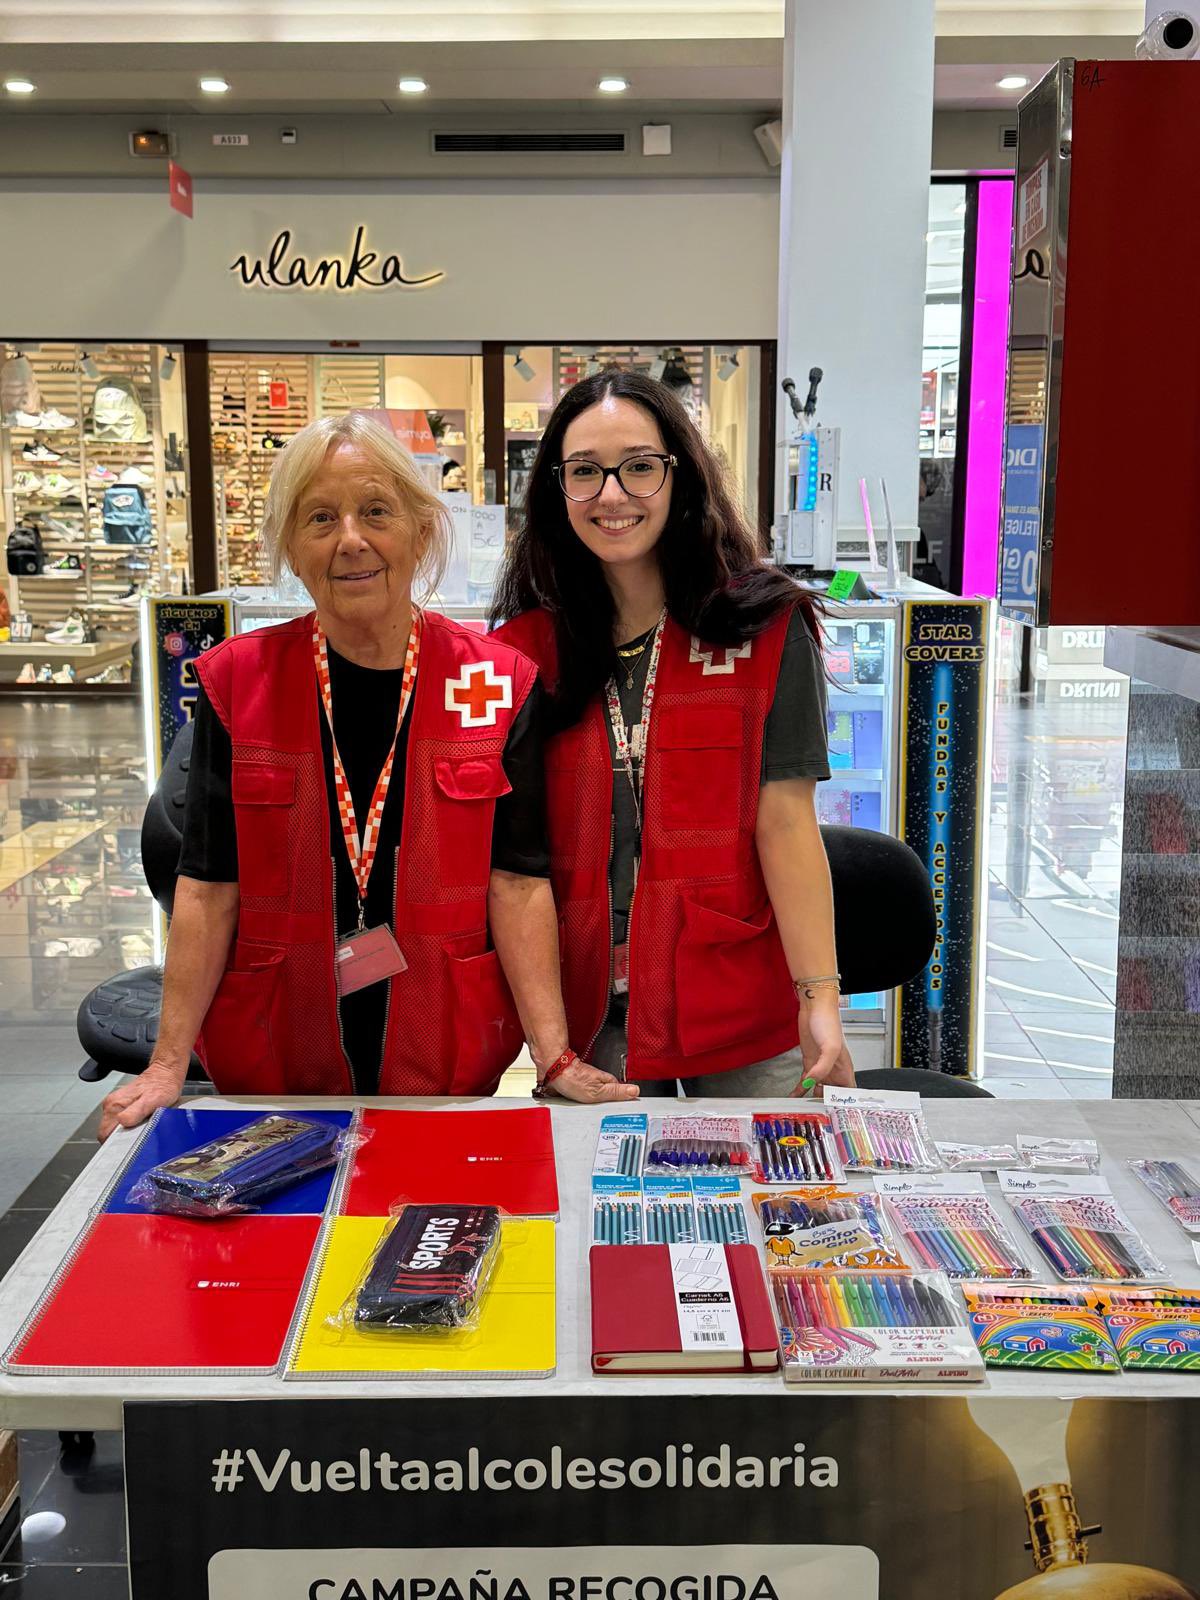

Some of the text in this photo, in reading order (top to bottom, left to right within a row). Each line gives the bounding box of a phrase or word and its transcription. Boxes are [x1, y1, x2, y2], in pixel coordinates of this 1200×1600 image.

[230, 227, 443, 287] ulanka
[919, 624, 973, 640] STAR
[904, 645, 985, 662] COVERS
[935, 702, 949, 793] FUNDAS
[933, 811, 946, 825] Y
[409, 1217, 460, 1271] SPORTS
[800, 1227, 862, 1248] Comfor
[826, 1236, 858, 1249] Grip
[937, 1370, 968, 1378] ALPINO
[211, 1442, 839, 1494] #Vueltaalcolesolidaria
[308, 1568, 780, 1600] CAMPAÑA RECOGIDA
